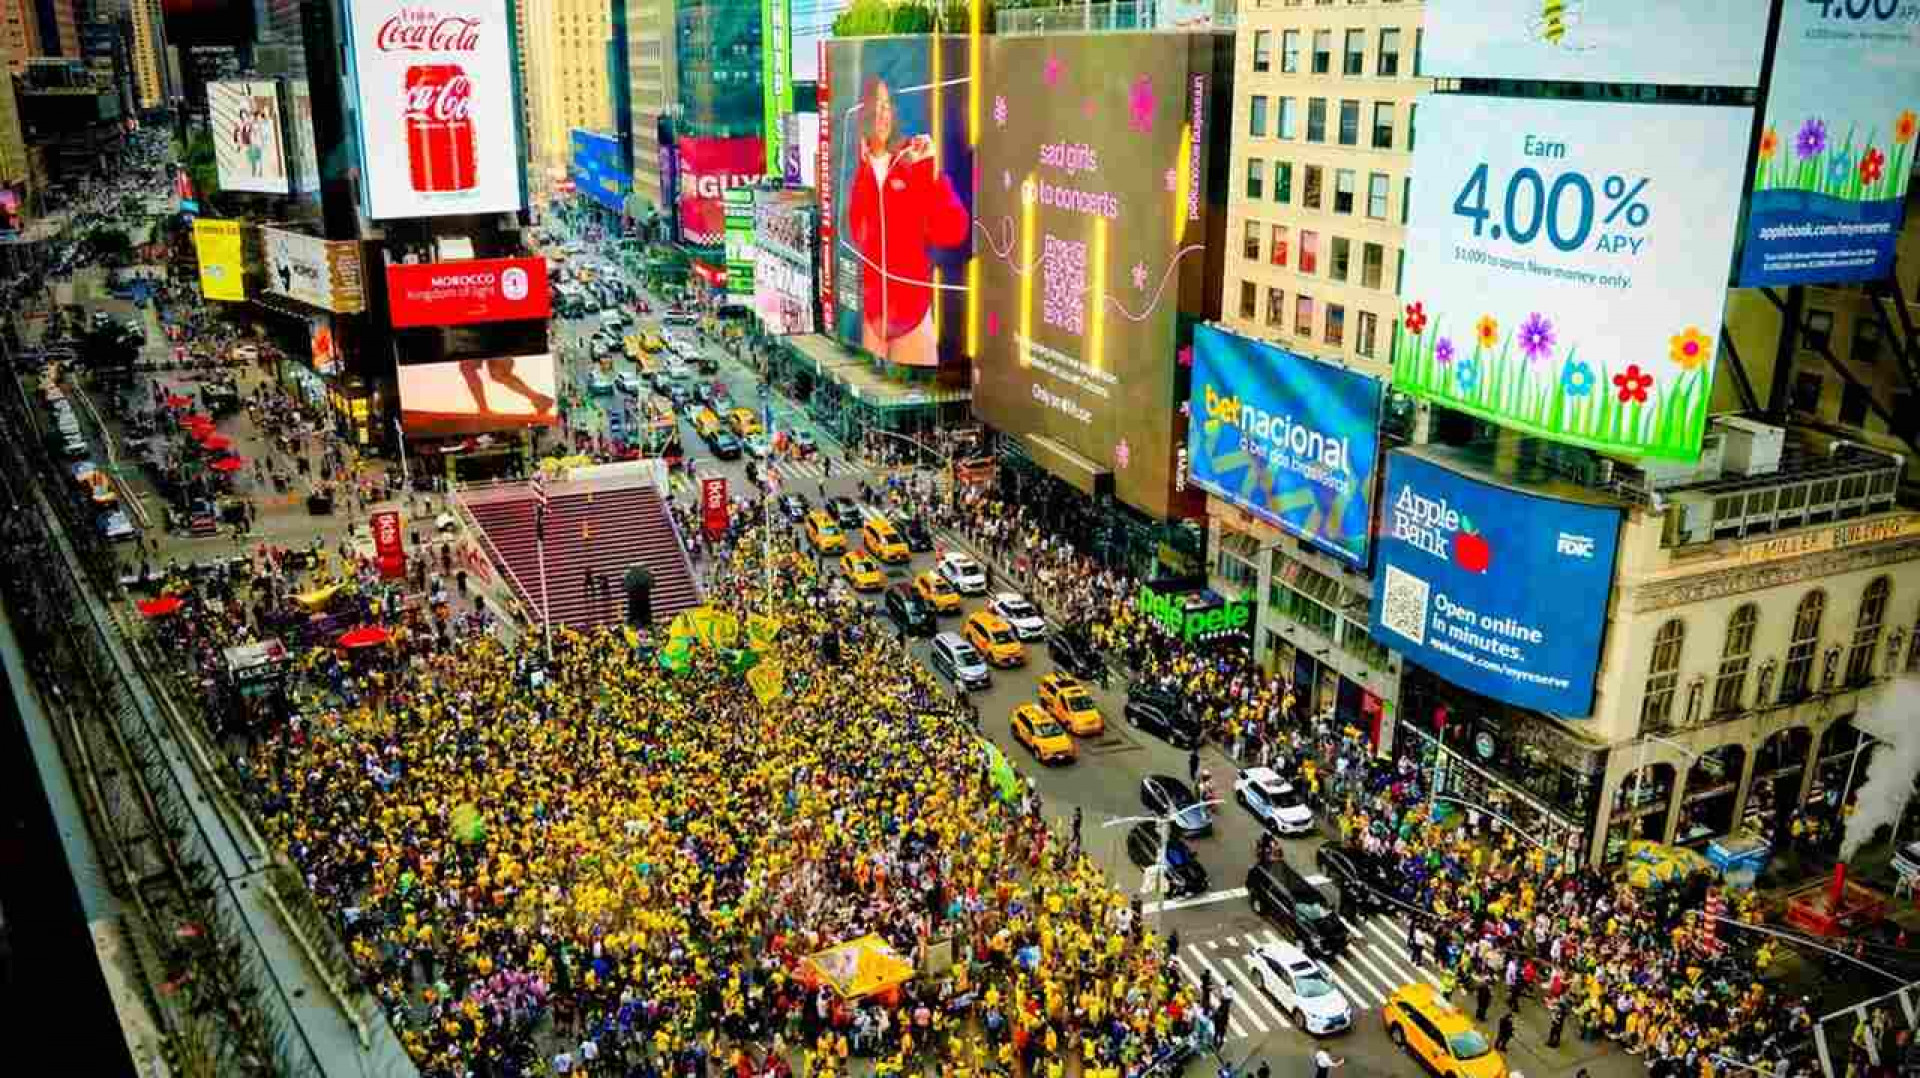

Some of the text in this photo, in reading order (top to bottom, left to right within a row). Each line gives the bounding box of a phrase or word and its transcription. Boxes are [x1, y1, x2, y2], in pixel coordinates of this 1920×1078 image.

[377, 16, 480, 51] Coca-Cola
[1040, 142, 1099, 176] sad girls
[1523, 133, 1567, 159] Earn
[1040, 179, 1054, 205] to
[1055, 186, 1118, 221] concerts
[1596, 233, 1646, 256] APY
[431, 272, 495, 288] MOROCCO
[1395, 483, 1460, 532] Apple
[1391, 511, 1449, 561] Bank
[1556, 538, 1595, 559] FDIC
[1434, 592, 1544, 644] Open online
[1448, 624, 1525, 662] minutes.
